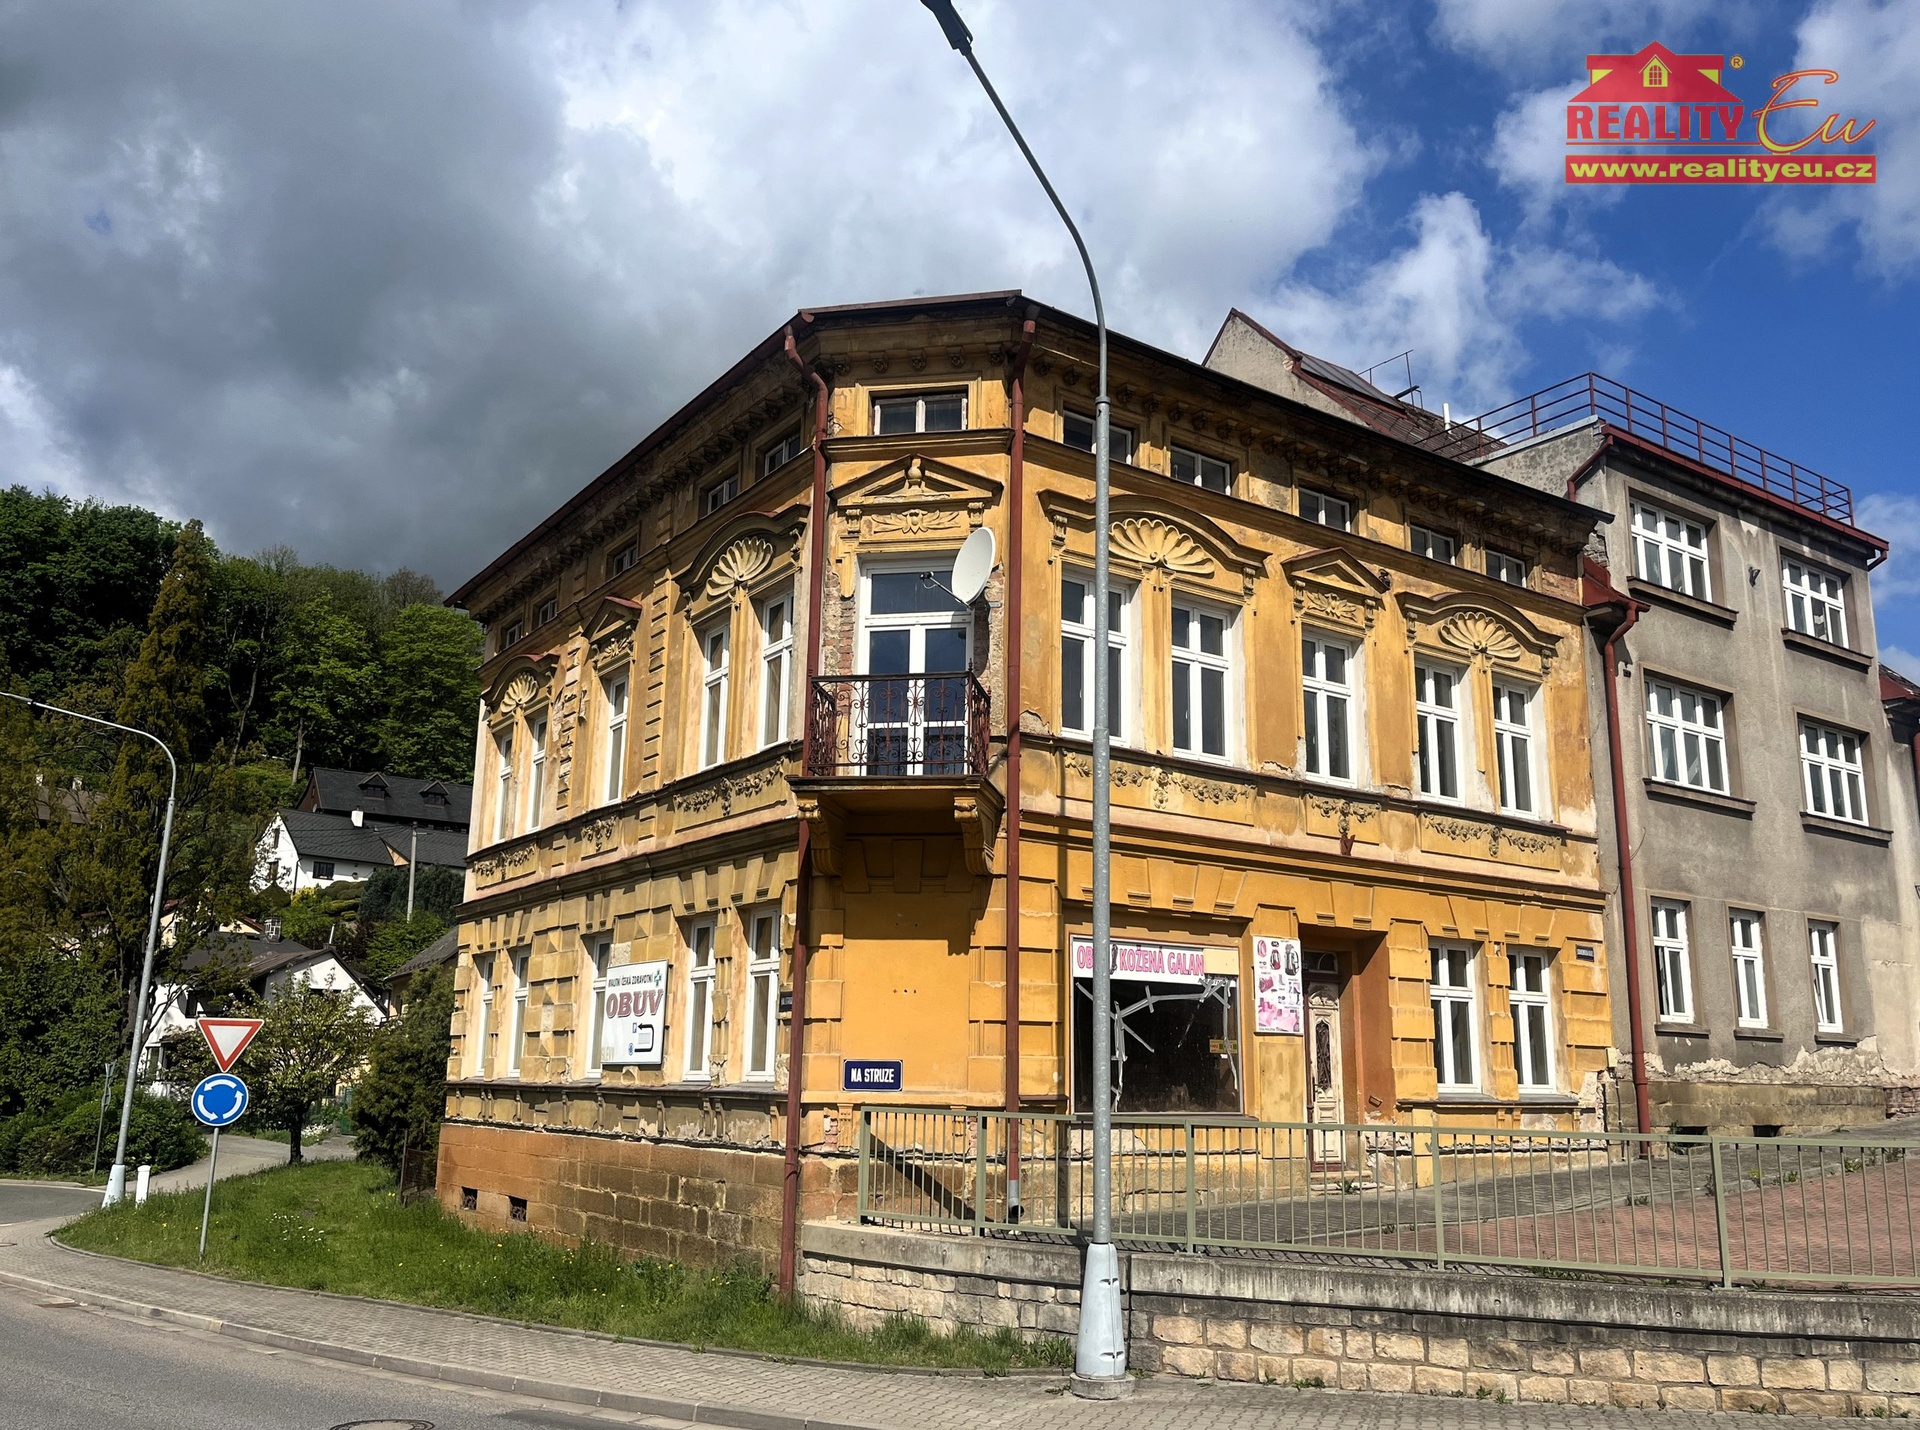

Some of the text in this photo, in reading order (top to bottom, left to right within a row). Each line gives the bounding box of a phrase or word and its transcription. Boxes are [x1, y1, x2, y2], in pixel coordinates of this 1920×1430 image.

[1119, 945, 1165, 974] KOŽENÁ
[1167, 952, 1205, 977] GALAN
[606, 989, 664, 1019] OBUV
[851, 1068, 894, 1082] NA STRUZE
